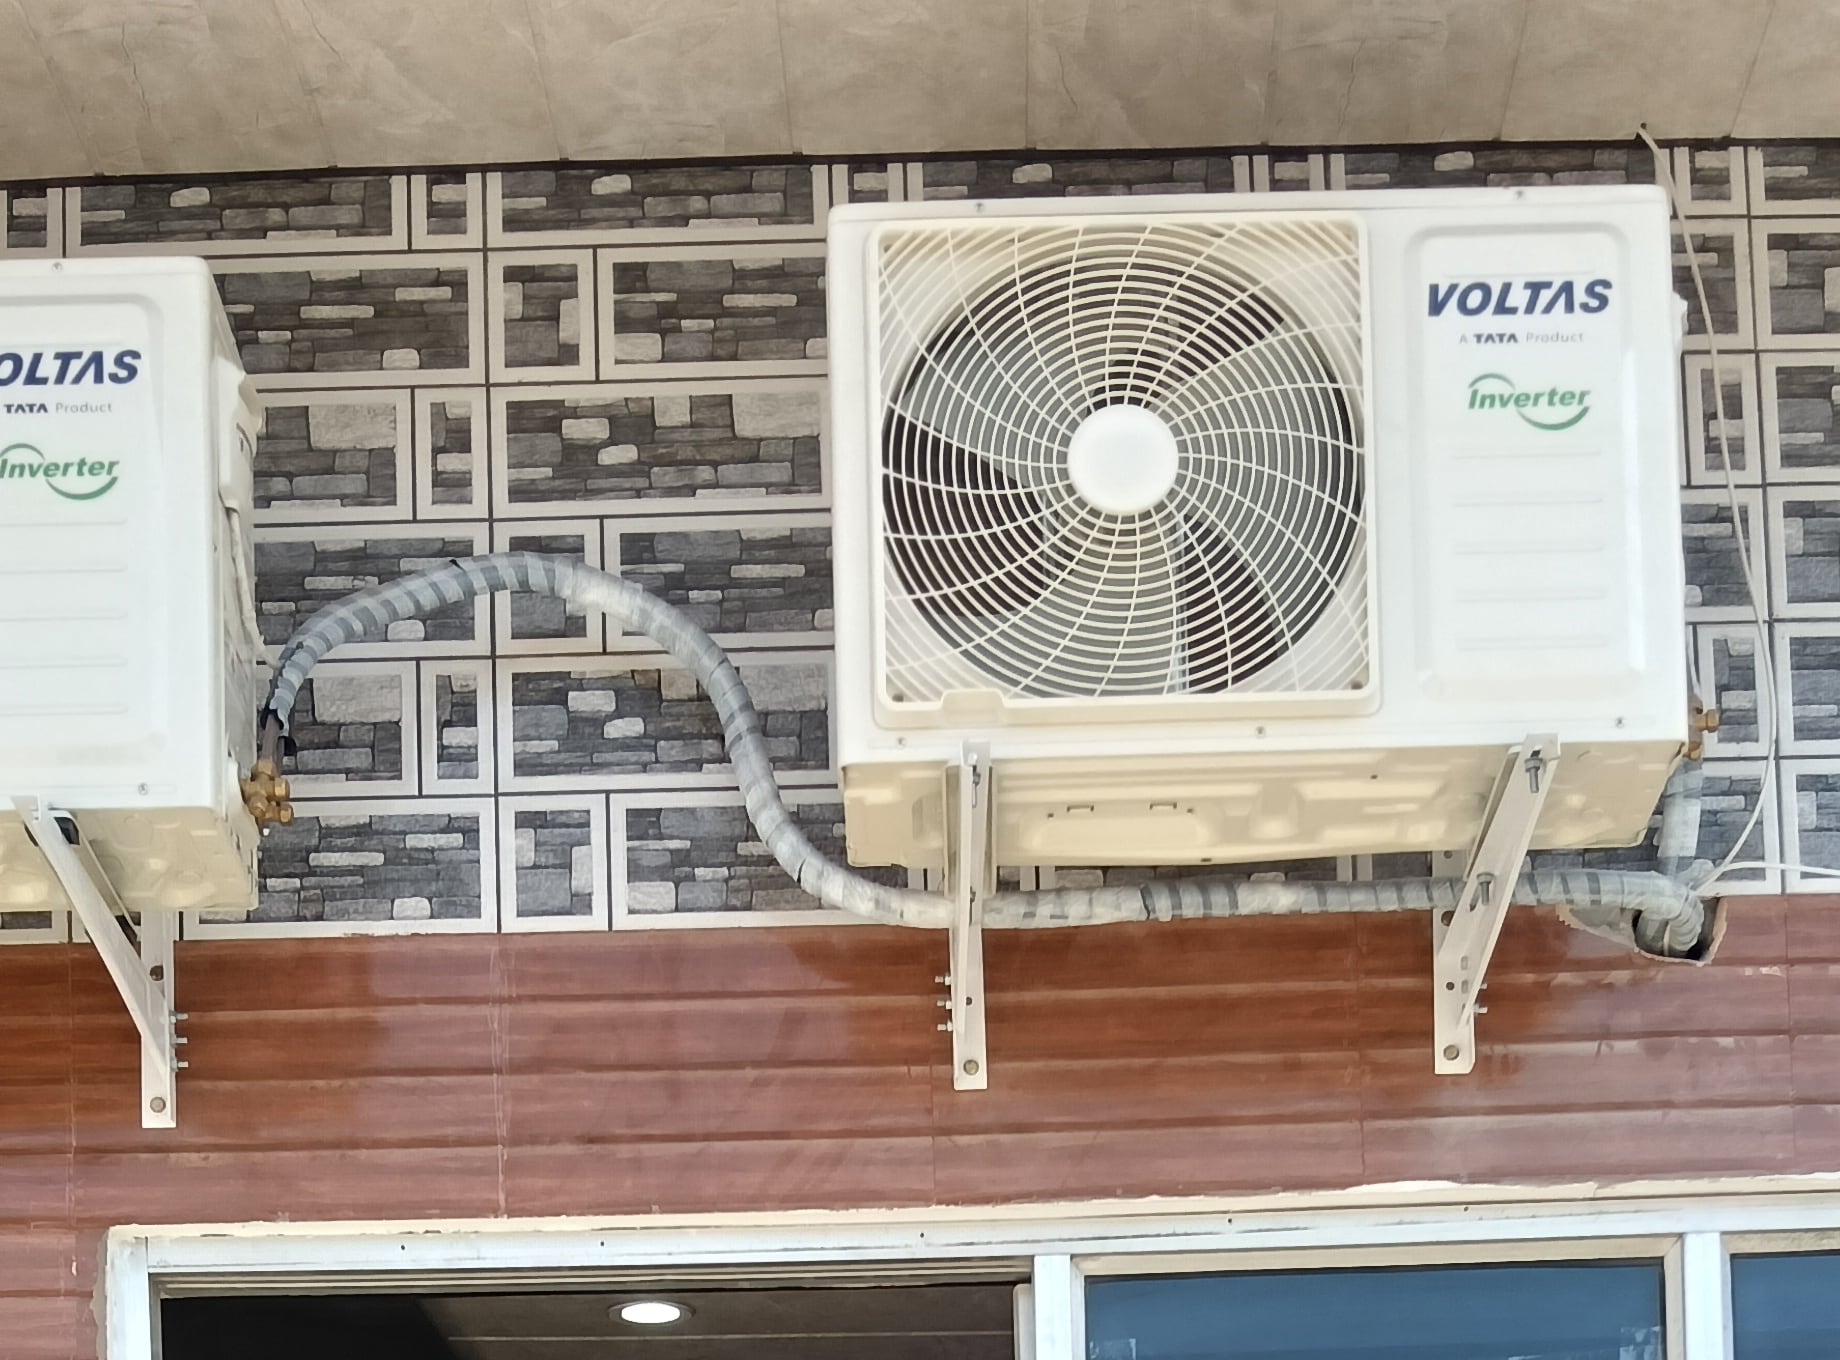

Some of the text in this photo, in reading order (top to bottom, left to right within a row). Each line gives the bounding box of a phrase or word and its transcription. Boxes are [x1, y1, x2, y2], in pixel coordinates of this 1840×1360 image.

[1427, 278, 1613, 317] VOLTAS
[1459, 331, 1584, 344] A TATA Product
[0, 349, 142, 387] OLTAS
[4, 402, 112, 414] TATA Product
[1468, 387, 1592, 410] Inverter
[0, 456, 120, 479] Inverter
